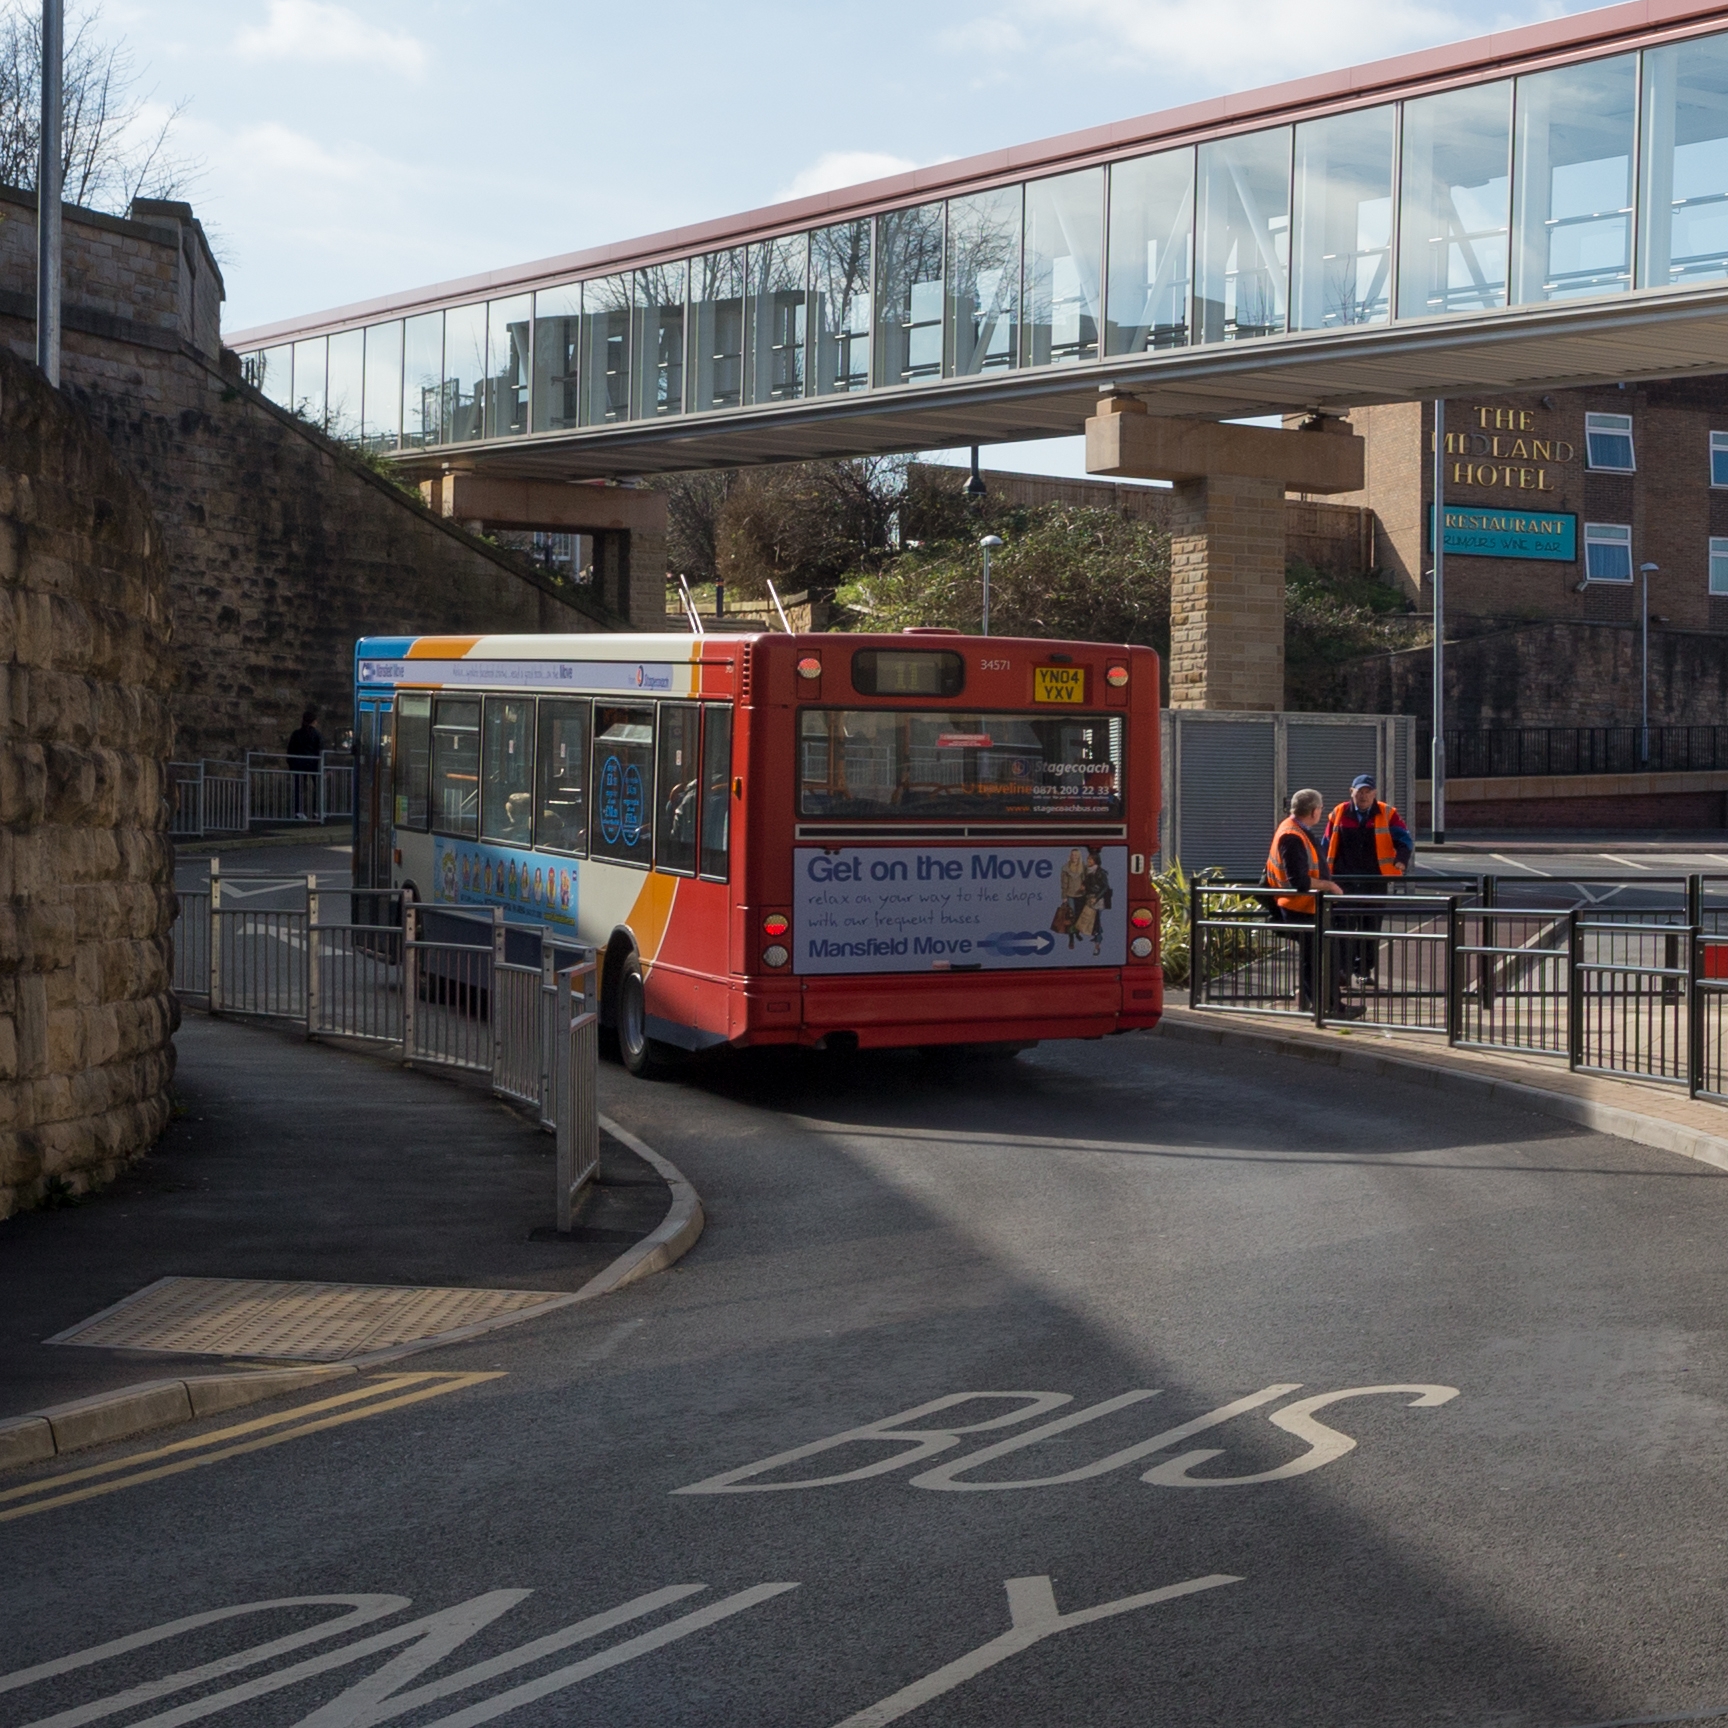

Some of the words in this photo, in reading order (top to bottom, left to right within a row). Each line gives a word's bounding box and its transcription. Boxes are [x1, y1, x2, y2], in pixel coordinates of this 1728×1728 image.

[1473, 405, 1535, 432] THE
[1452, 462, 1555, 491] HOTEL
[1444, 512, 1566, 536] RESTAURANT
[1535, 541, 1562, 553] BAR
[893, 661, 920, 690] 11
[980, 658, 1011, 671] 34571
[1040, 668, 1080, 684] YN04
[1043, 685, 1075, 701] YXV
[1034, 760, 1110, 776] Stagecoach
[1033, 786, 1057, 795] 0871
[1060, 786, 1079, 795] 200
[1082, 786, 1095, 795] 22
[1098, 786, 1110, 795] 33
[807, 855, 862, 882] Get
[870, 860, 908, 882] on
[916, 855, 964, 880] the
[970, 854, 1053, 880] Move
[808, 889, 850, 905] relax
[855, 893, 873, 905] on
[878, 892, 913, 909] your
[918, 892, 951, 907] way
[956, 886, 971, 903] to
[977, 886, 1000, 903] the
[1005, 886, 1044, 905] shops
[808, 912, 838, 928] with
[843, 914, 869, 927] our
[873, 910, 934, 932] frequent
[939, 910, 982, 926] buses
[808, 936, 908, 958] Mansfield
[913, 936, 973, 955] Move
[668, 1381, 1461, 1497] BUS
